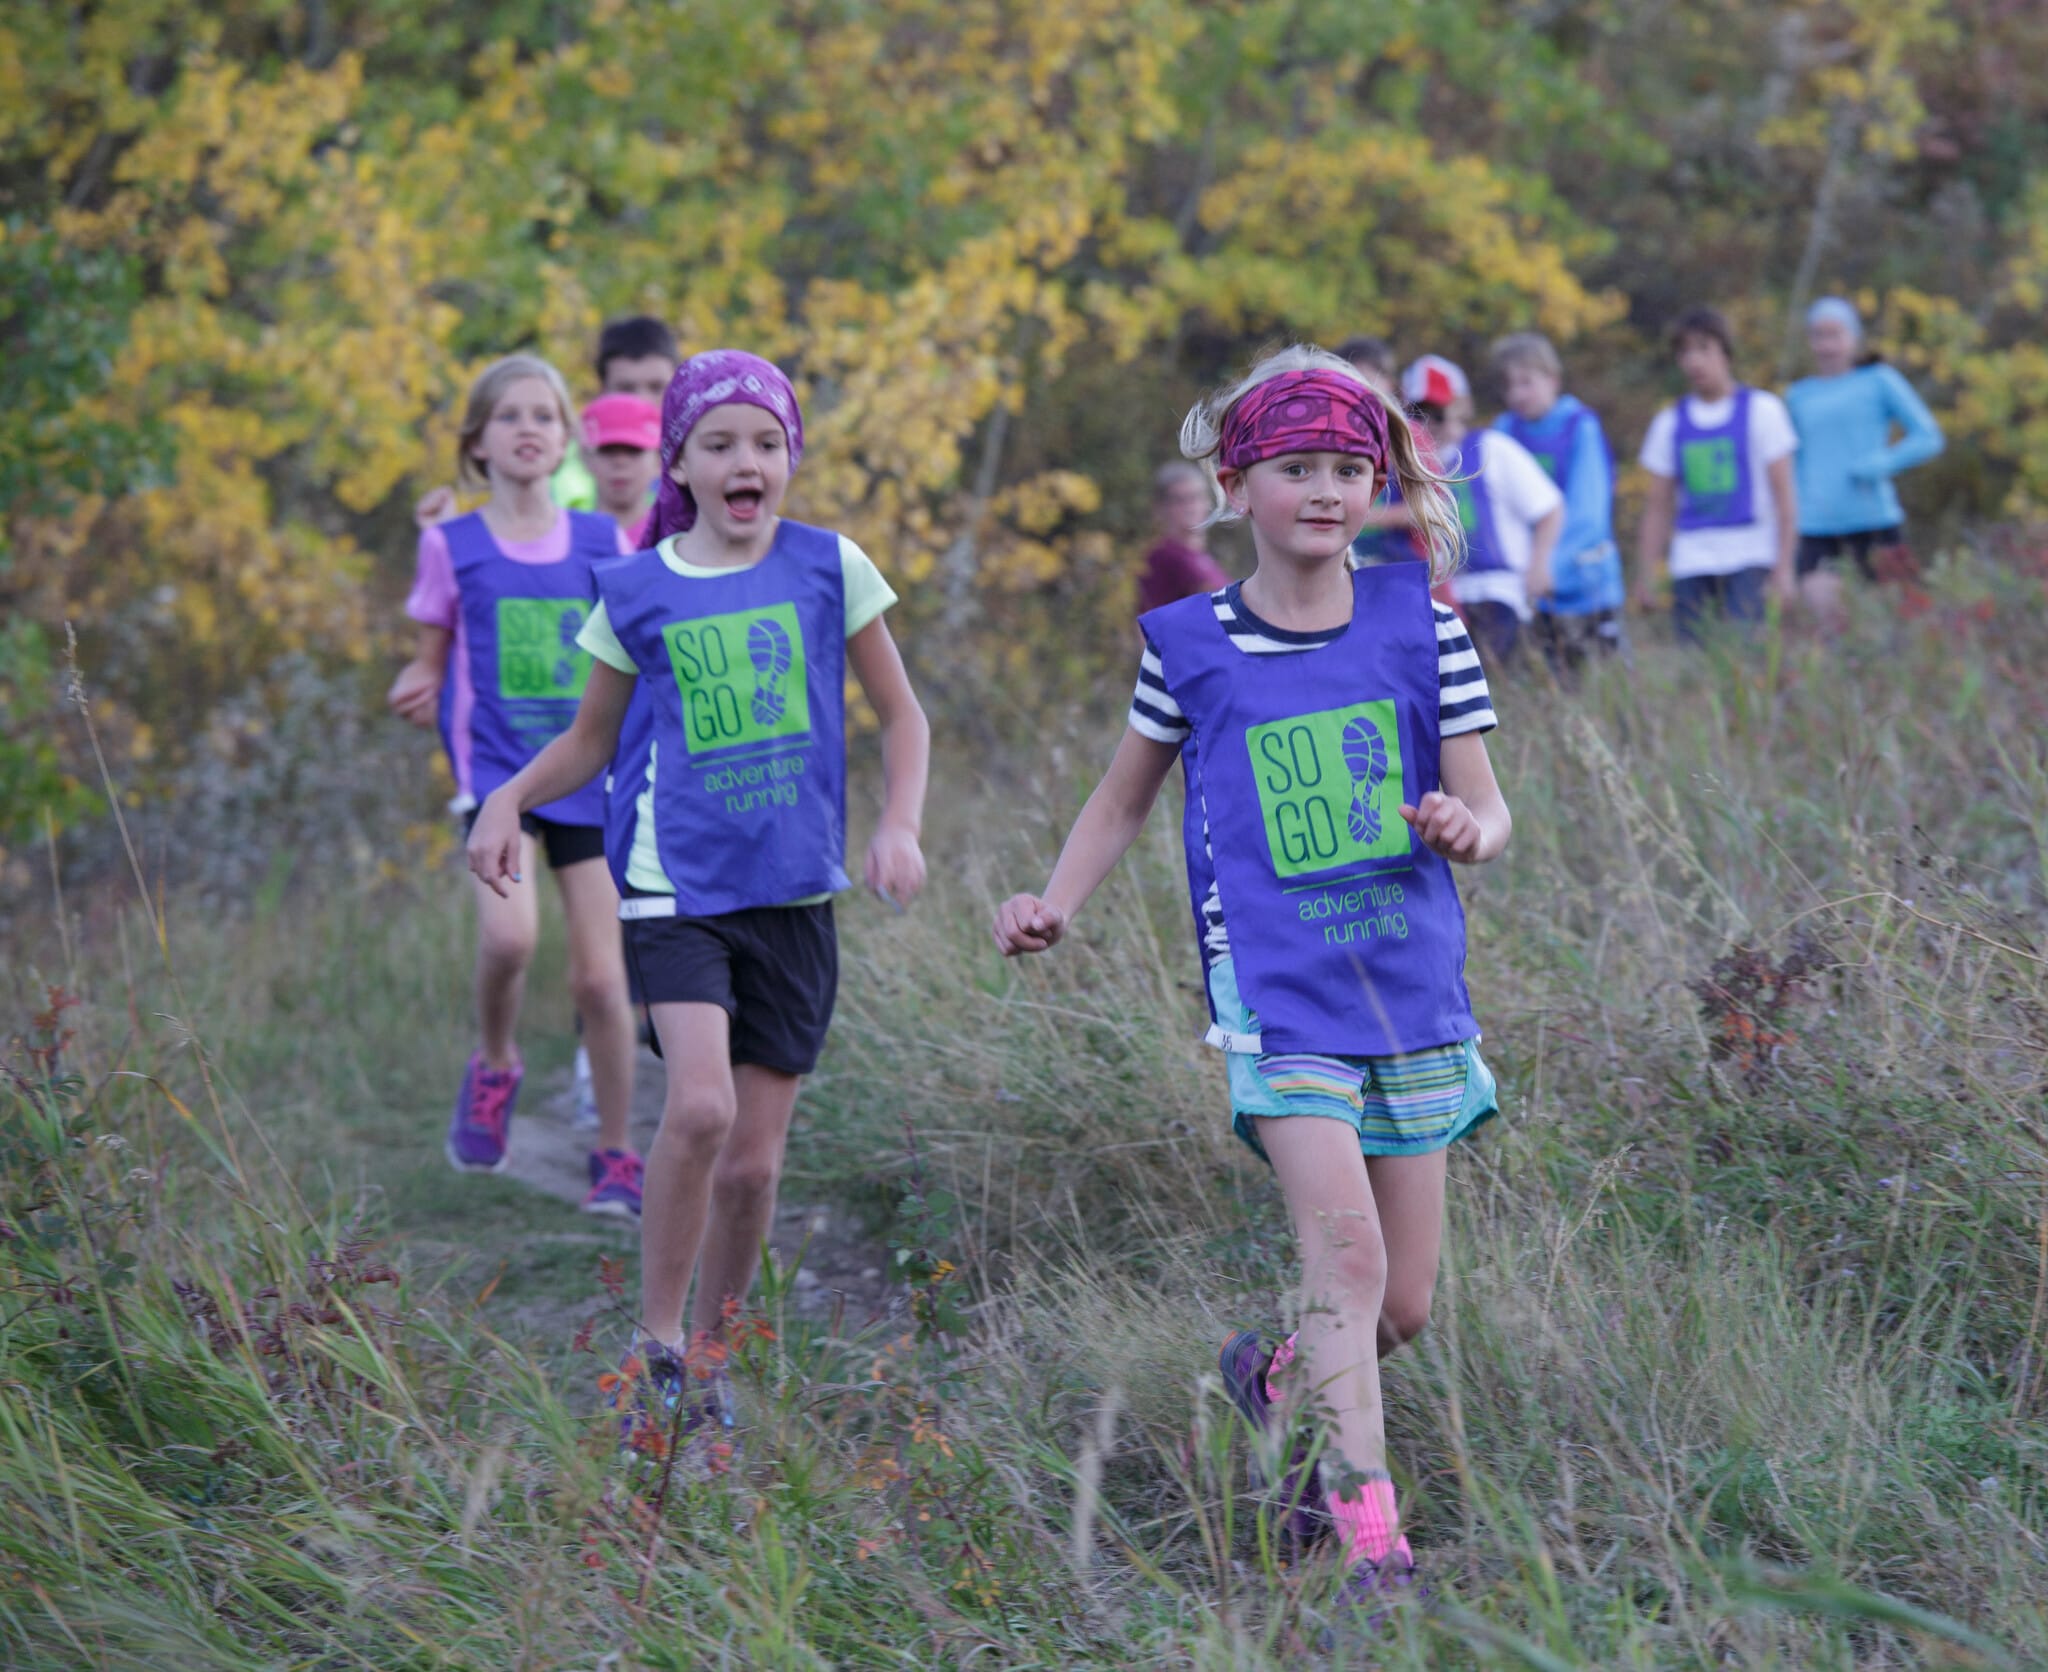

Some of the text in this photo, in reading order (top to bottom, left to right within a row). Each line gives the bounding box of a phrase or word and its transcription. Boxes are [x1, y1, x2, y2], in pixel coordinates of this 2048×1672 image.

[675, 624, 729, 683] SO
[690, 683, 743, 742] GO
[1260, 725, 1322, 794] SO
[1275, 795, 1339, 864] GO
[1298, 882, 1405, 921] adventure
[1324, 911, 1409, 945] running
